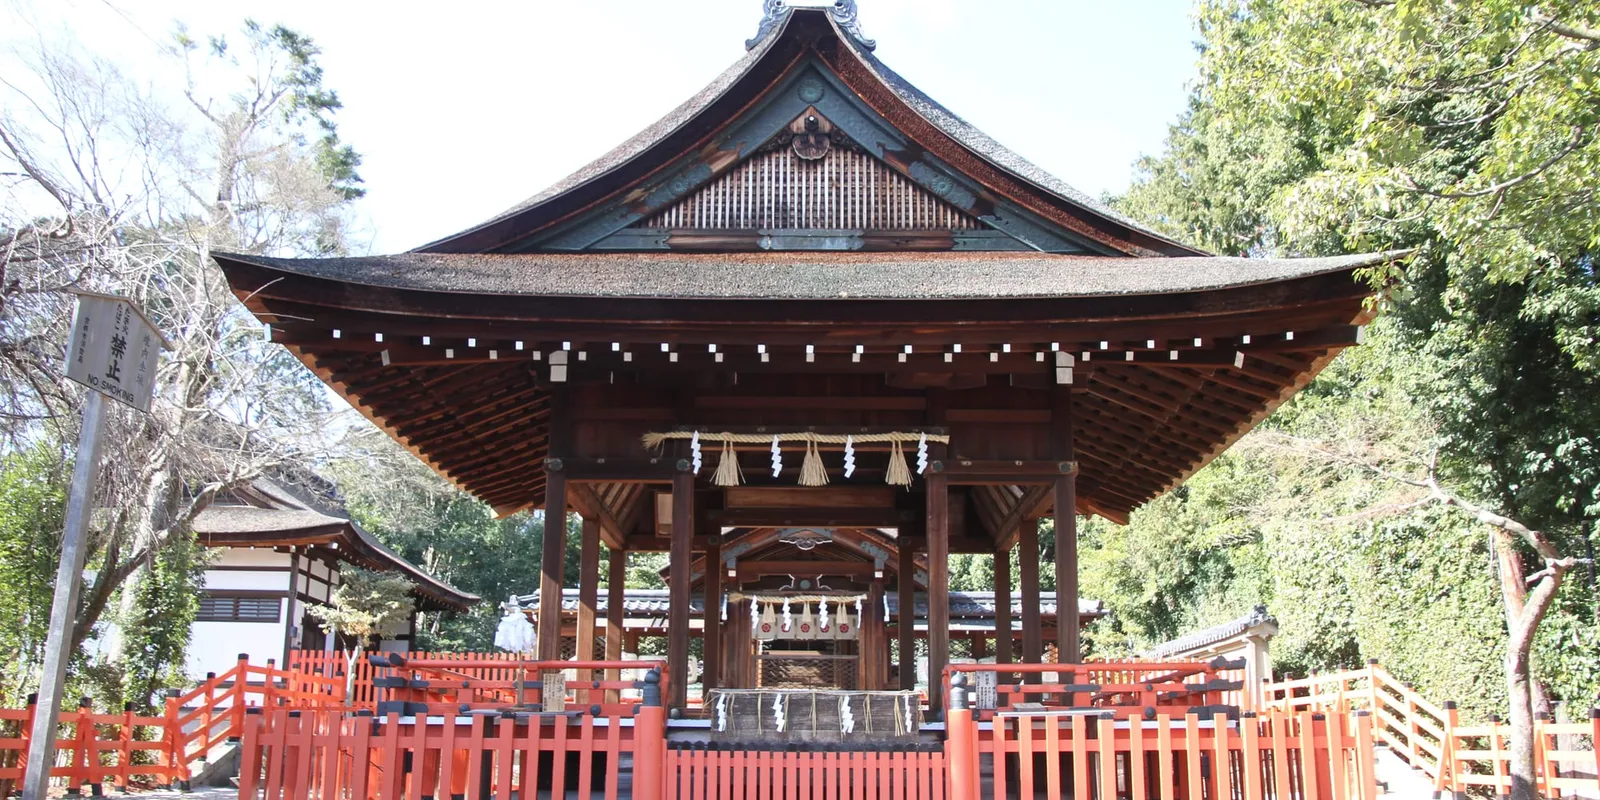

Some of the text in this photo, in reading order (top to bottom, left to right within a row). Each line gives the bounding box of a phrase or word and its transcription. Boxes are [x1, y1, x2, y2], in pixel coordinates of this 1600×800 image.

[105, 333, 127, 383] 禁止
[87, 373, 134, 403] NO SMOKING
